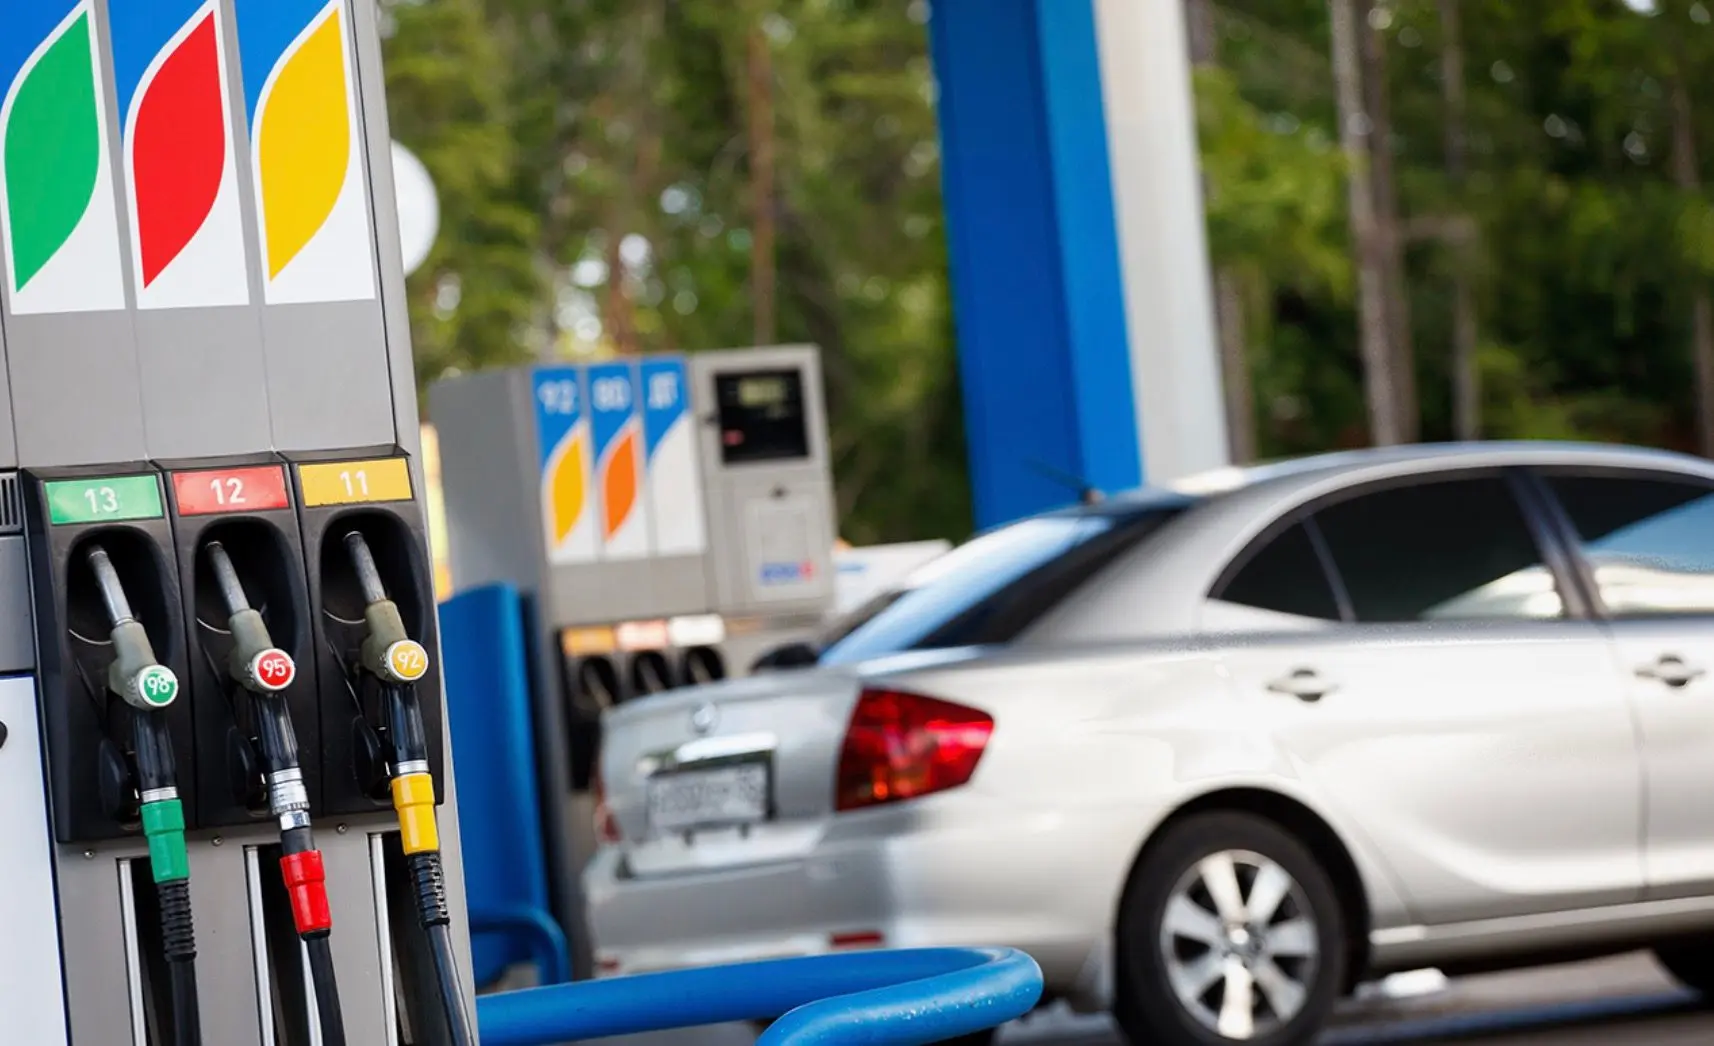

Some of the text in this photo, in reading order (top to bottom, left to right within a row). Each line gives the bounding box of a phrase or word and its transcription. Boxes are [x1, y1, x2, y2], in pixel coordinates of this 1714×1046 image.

[209, 476, 246, 505] 12
[339, 469, 369, 497] 11
[84, 486, 118, 513] 13
[262, 658, 286, 678] 95
[397, 650, 421, 669] 92
[146, 674, 170, 695] 98
